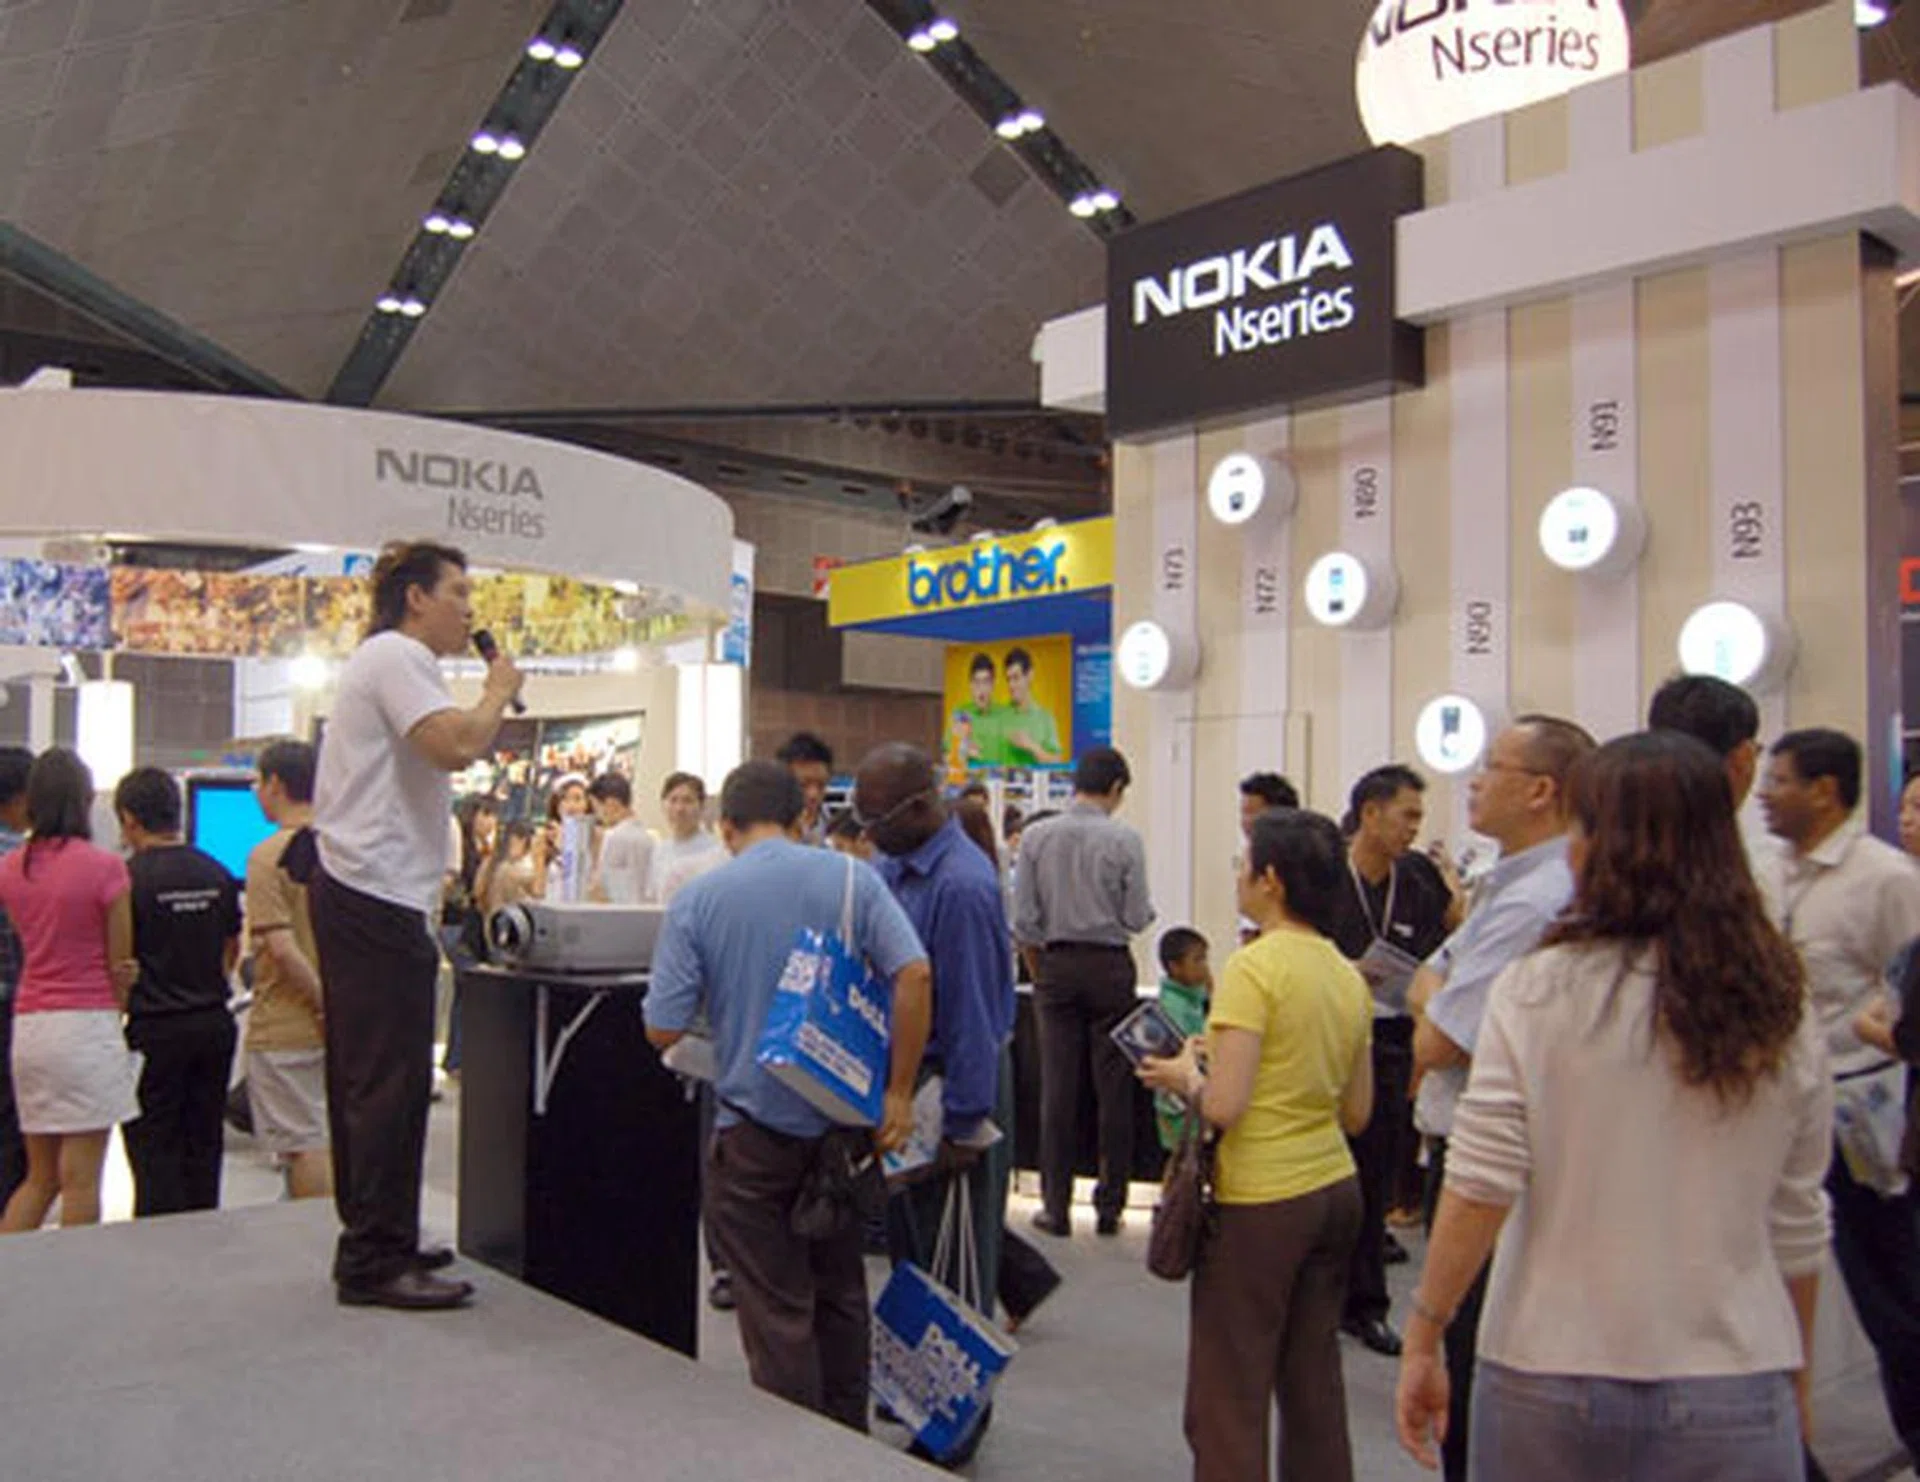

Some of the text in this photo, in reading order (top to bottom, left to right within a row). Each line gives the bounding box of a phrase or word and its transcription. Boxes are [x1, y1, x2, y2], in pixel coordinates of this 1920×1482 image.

[1431, 15, 1599, 80] Nseries
[1133, 223, 1353, 325] NOKIA
[1215, 286, 1354, 356] Nseries
[1590, 401, 1618, 451] N91
[375, 447, 543, 501] NOKIA
[1355, 467, 1378, 518] N80
[448, 494, 545, 539] Nseries
[1731, 501, 1763, 559] N93
[907, 540, 1068, 607] brother.
[1255, 567, 1276, 614] N72
[1466, 602, 1491, 655] N90
